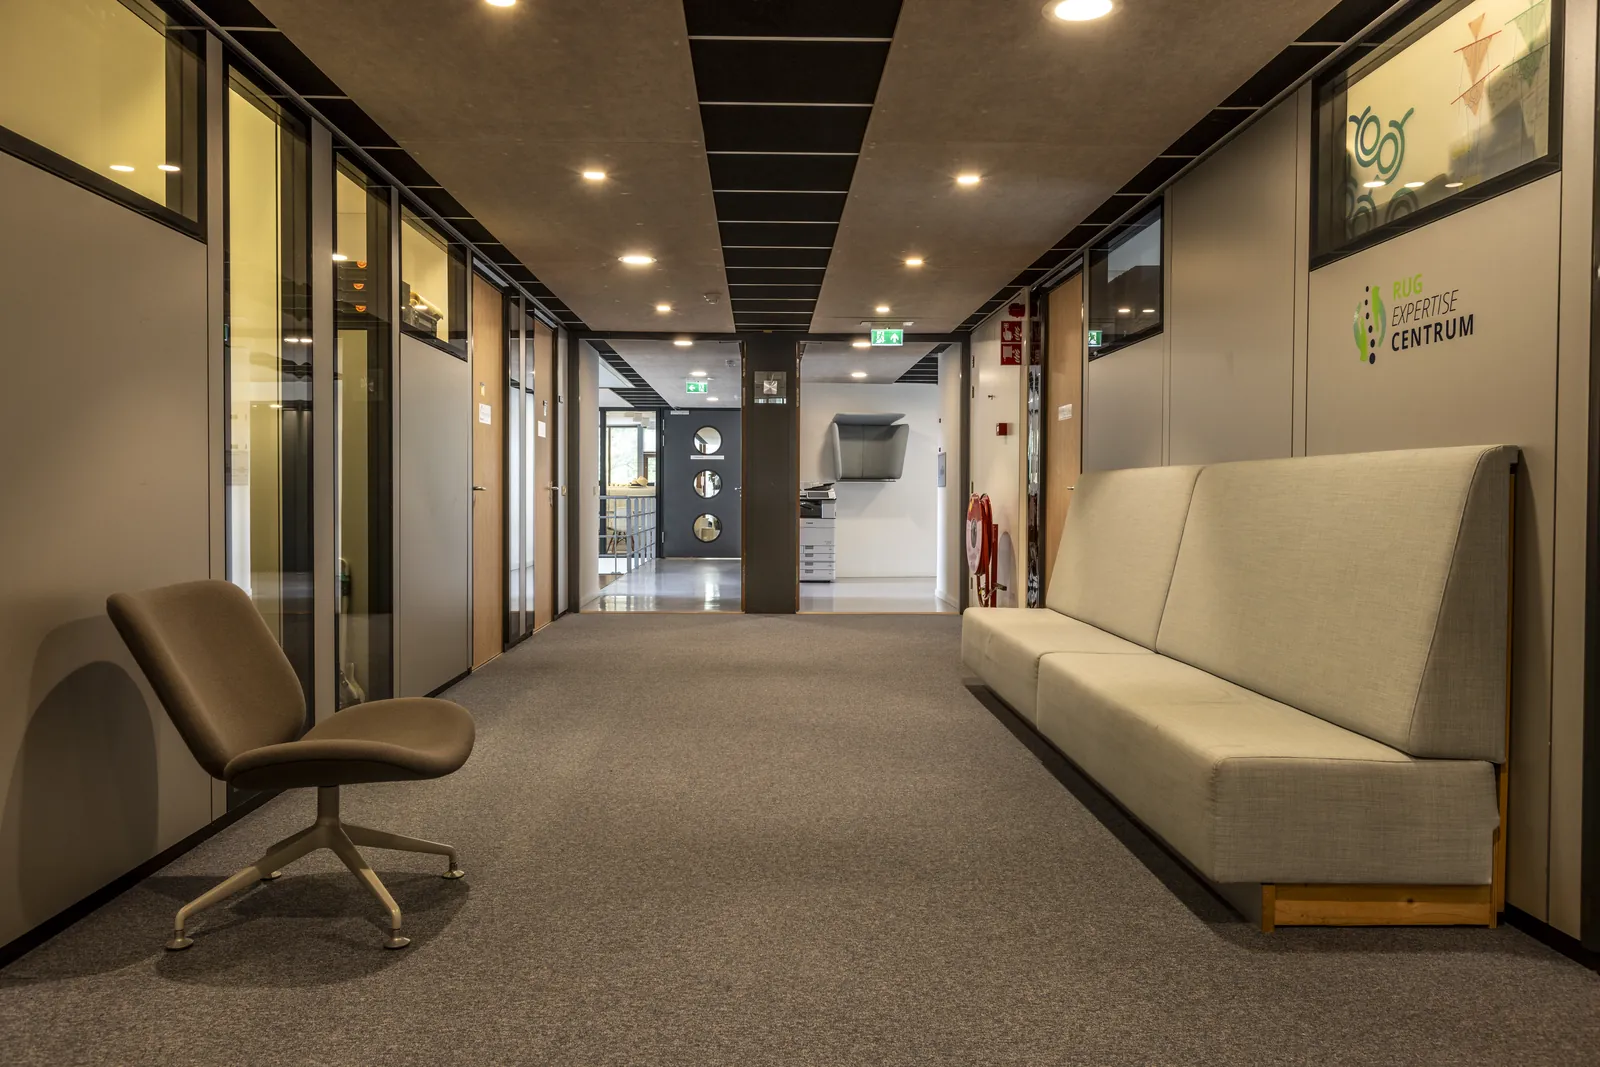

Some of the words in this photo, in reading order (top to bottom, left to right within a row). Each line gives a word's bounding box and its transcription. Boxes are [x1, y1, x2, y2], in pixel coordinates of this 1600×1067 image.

[1393, 273, 1423, 301] RUG
[1391, 289, 1459, 327] EXPERTISE
[1391, 313, 1474, 352] CENTRUM
